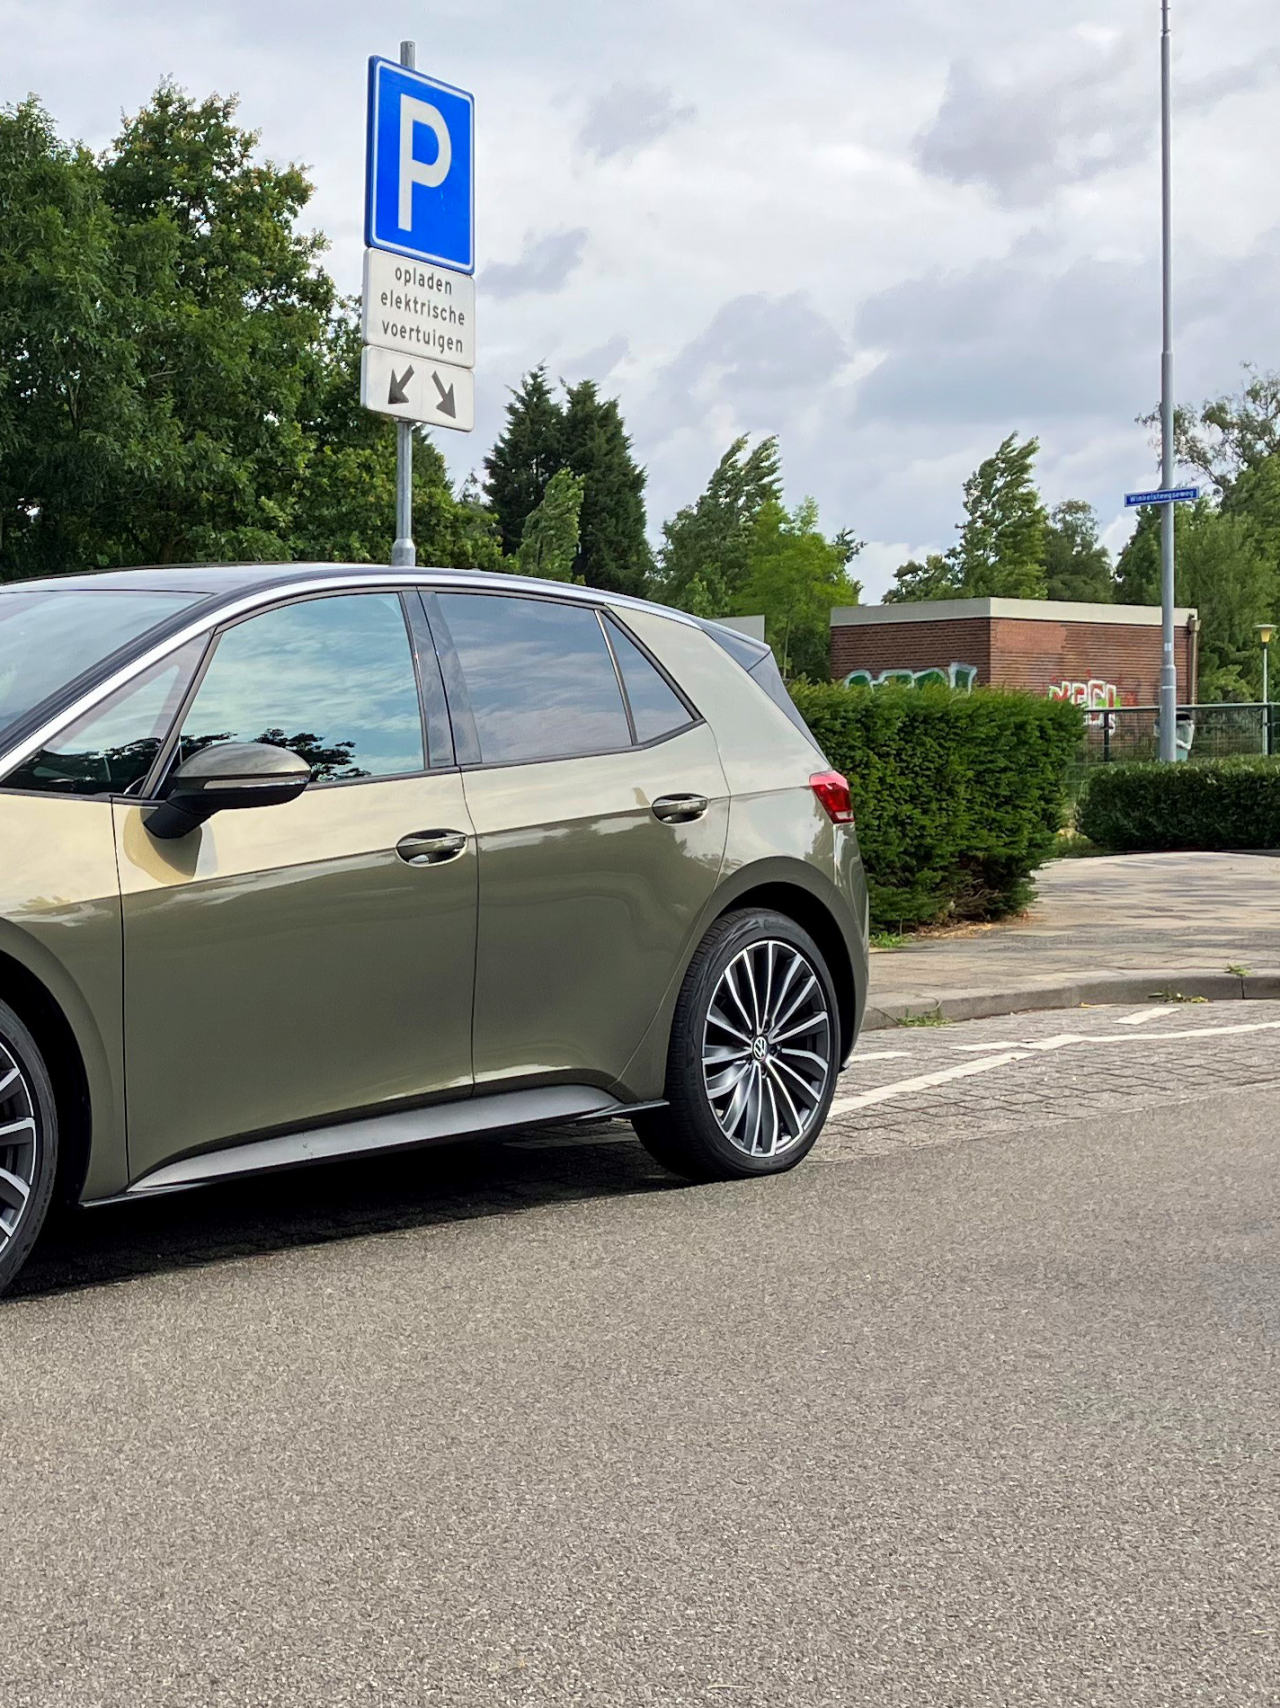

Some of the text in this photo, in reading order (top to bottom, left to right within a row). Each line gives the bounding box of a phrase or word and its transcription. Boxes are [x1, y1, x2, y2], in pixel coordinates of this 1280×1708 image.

[398, 93, 452, 232] P
[395, 267, 452, 295] opladen
[380, 289, 465, 326] elektrische
[381, 320, 463, 354] voertuigen
